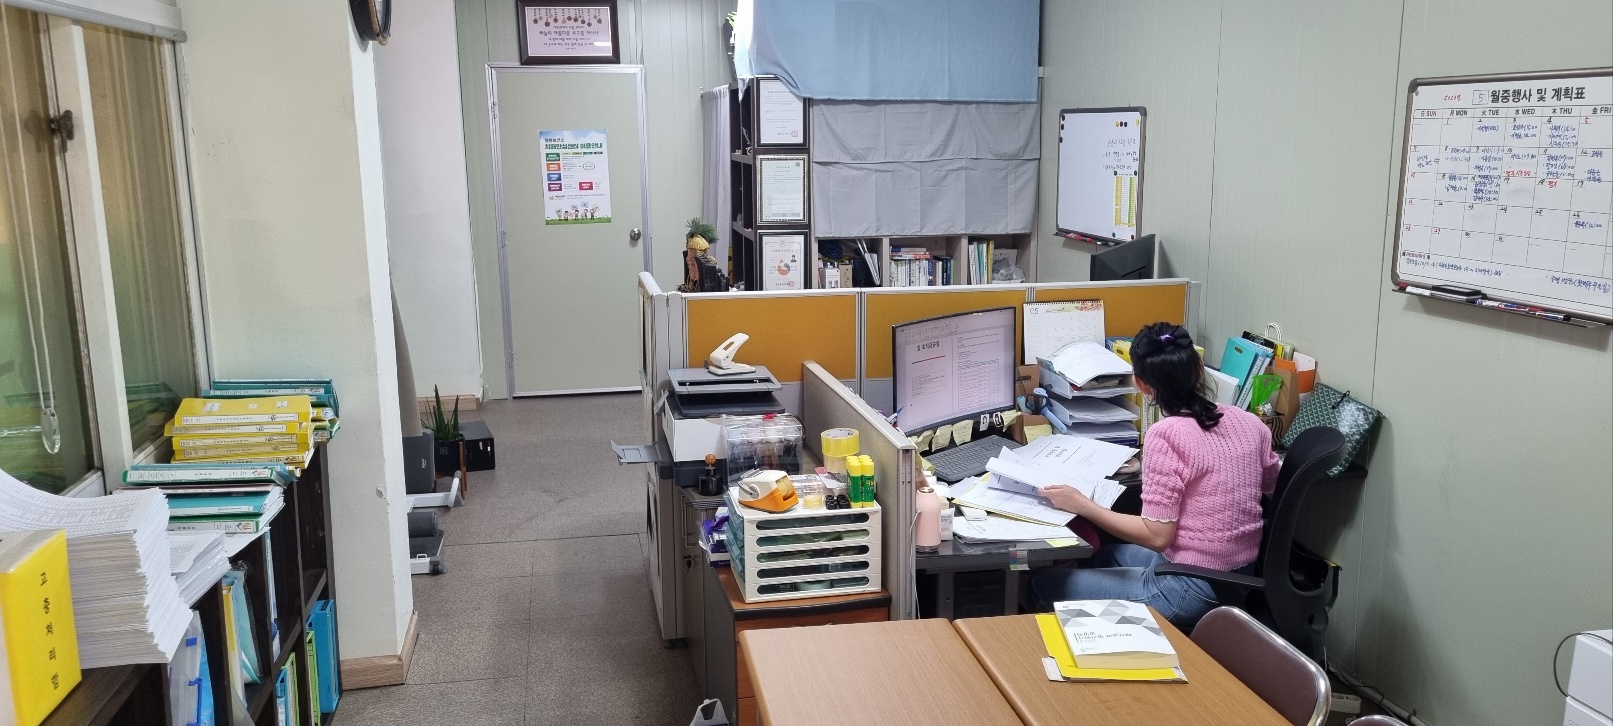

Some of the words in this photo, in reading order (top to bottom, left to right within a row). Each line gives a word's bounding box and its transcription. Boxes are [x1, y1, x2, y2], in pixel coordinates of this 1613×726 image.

[1490, 88, 1532, 104] 월중행사
[1536, 87, 1547, 102] 및
[1551, 86, 1586, 102] 계획표
[1551, 107, 1558, 115] 木
[1559, 107, 1573, 115] THU
[1591, 106, 1598, 115] 金
[1600, 106, 1612, 114] FRI
[1029, 307, 1039, 315] 05
